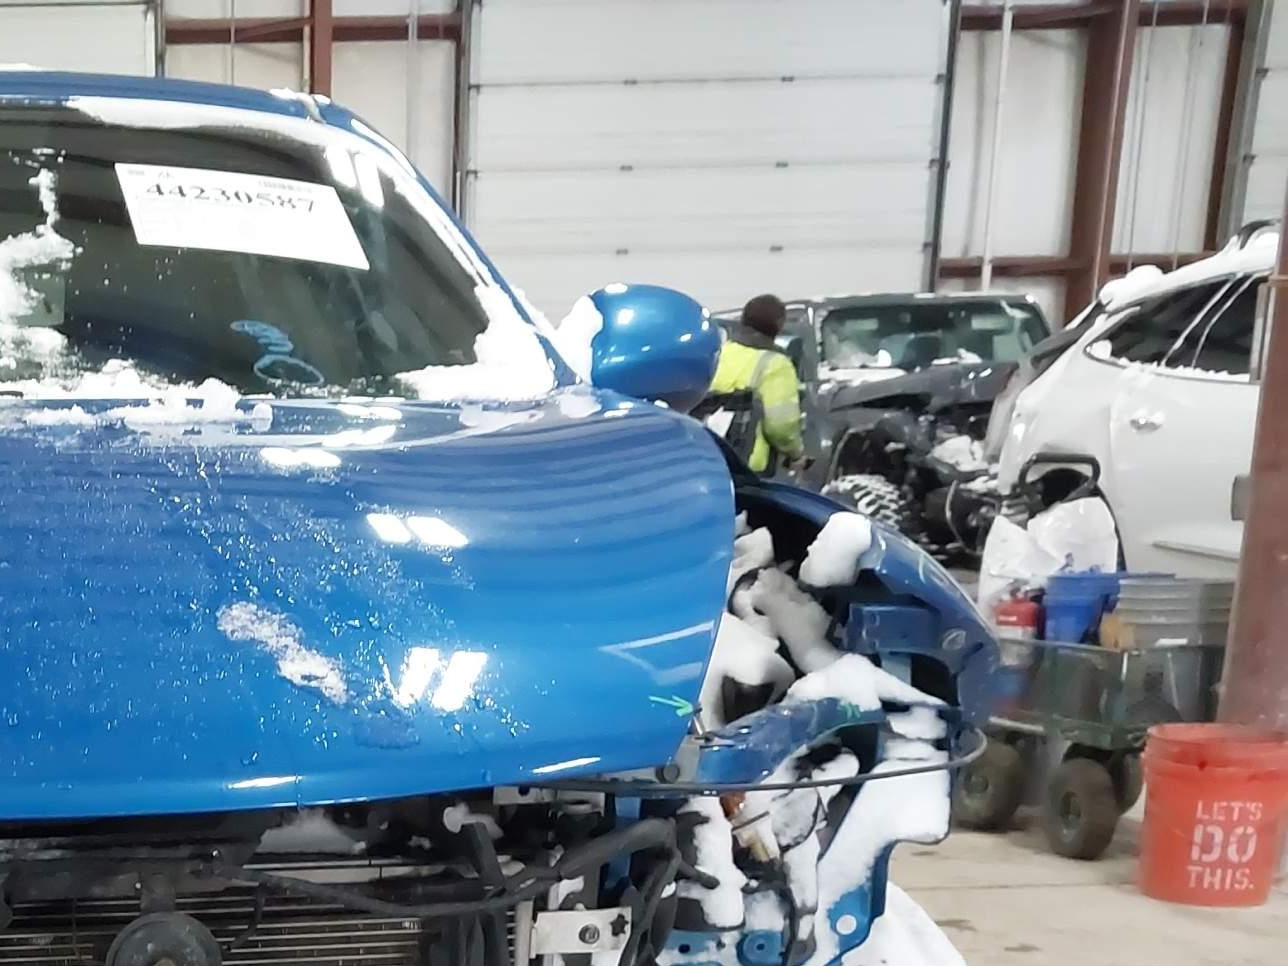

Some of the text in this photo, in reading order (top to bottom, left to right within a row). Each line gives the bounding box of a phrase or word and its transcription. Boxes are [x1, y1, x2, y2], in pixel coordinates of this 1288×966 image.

[146, 183, 314, 213] 44230587
[1195, 800, 1263, 821] LET'S
[1190, 823, 1258, 863] DO
[1187, 865, 1255, 890] THIS.
